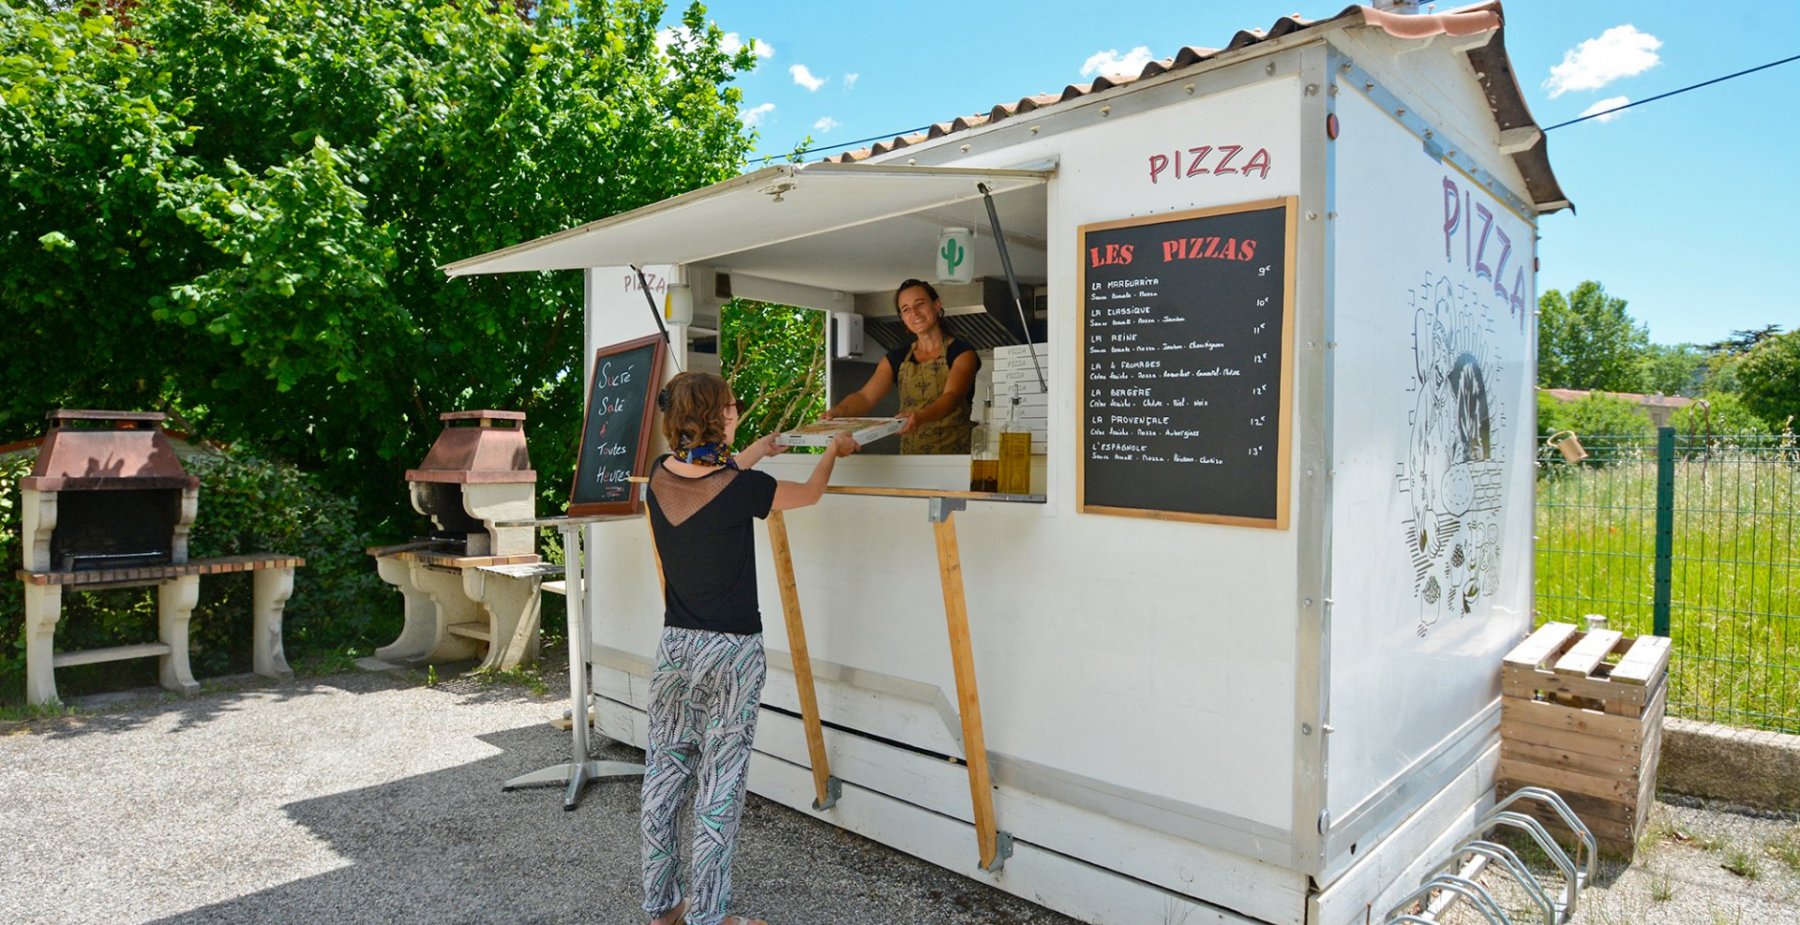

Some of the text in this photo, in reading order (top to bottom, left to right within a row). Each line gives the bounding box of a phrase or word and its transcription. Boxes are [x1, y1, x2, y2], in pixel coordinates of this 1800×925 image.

[1149, 145, 1271, 185] PIZZA
[1090, 237, 1257, 267] LES PIZZAS
[1442, 174, 1527, 331] PIZZA
[1091, 308, 1101, 316] LA
[1007, 360, 1026, 368] PIZZA
[1121, 361, 1161, 369] FROMAGES
[598, 361, 634, 389] Sucré
[1006, 372, 1024, 380] PIZZA
[1091, 386, 1152, 397] LA BERGÈRE
[598, 396, 625, 416] Salé
[1092, 415, 1170, 426] LA PROVENÇALE
[597, 443, 627, 456] Toutes
[596, 466, 630, 484] Heures
